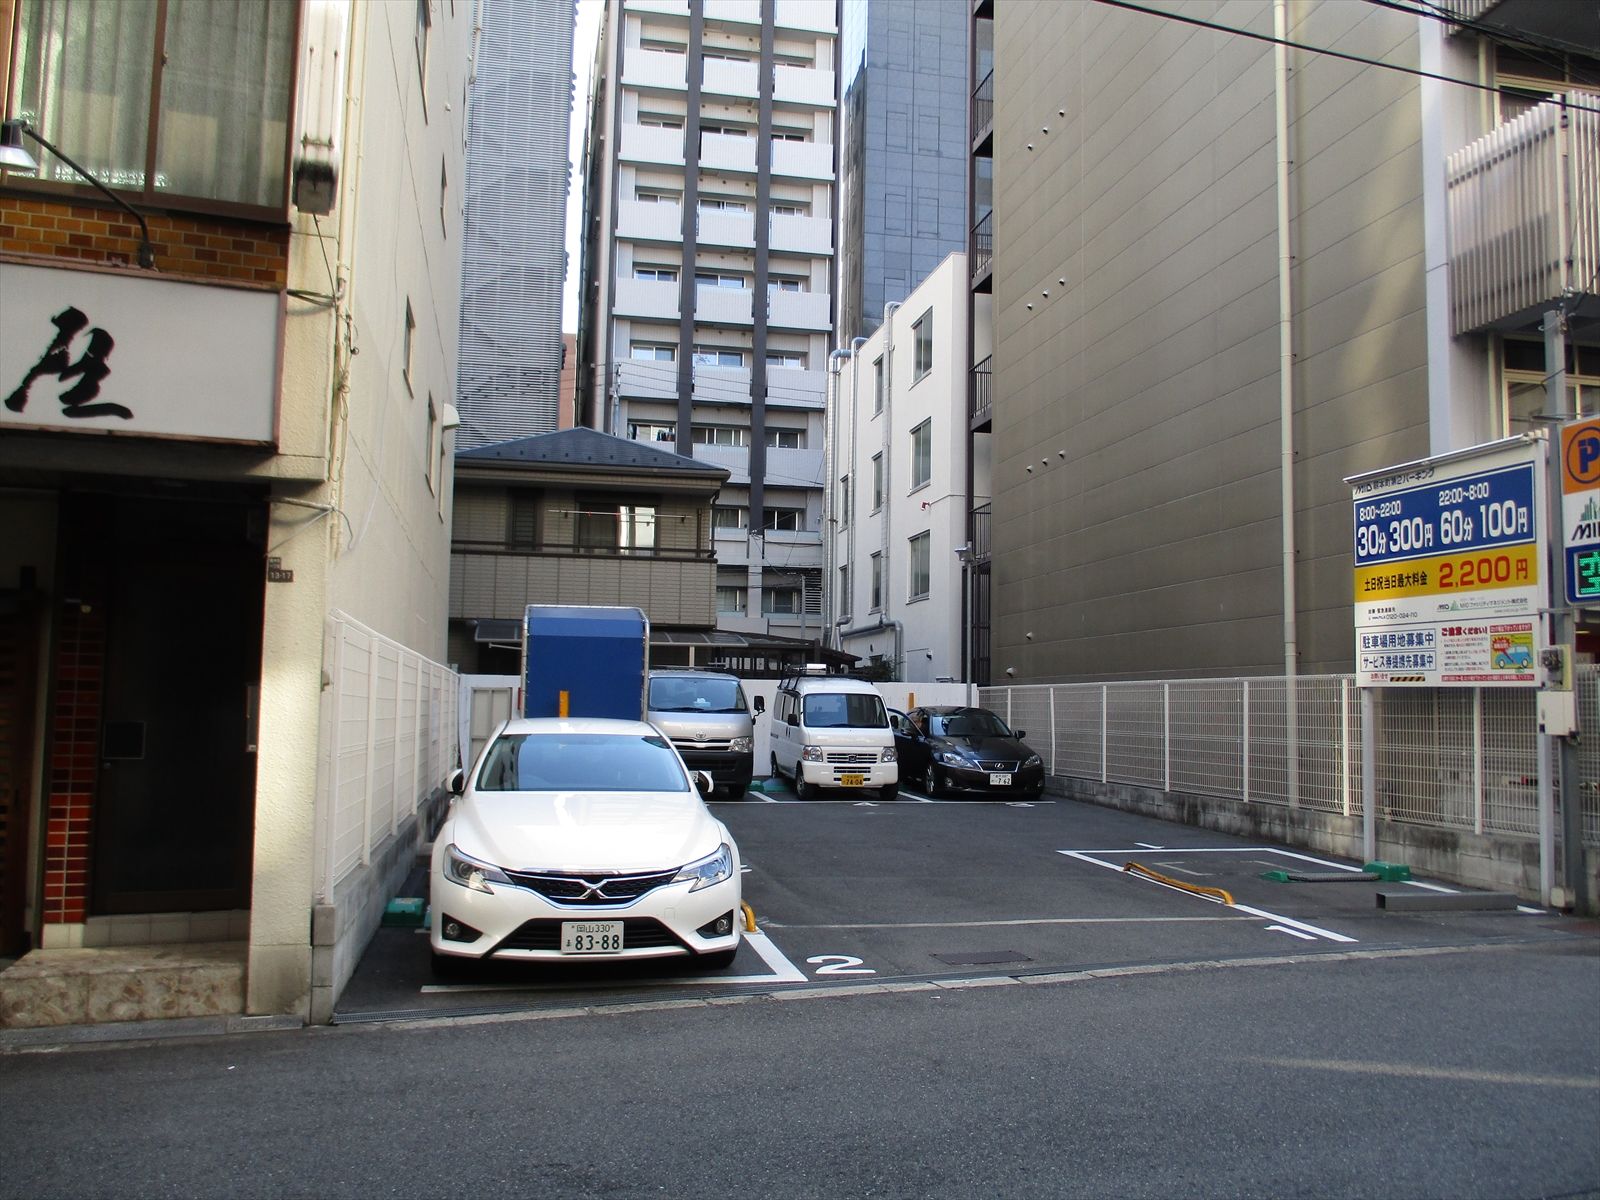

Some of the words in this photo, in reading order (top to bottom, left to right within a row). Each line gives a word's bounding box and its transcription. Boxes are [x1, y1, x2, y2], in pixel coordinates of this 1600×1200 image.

[1440, 510, 1473, 545] 60分
[1480, 500, 1528, 538] 100円
[1571, 520, 1600, 541] MI
[1358, 524, 1387, 557] 30分
[1389, 517, 1433, 553] 300円
[1364, 571, 1428, 592] 土日祝当日最大料金
[1362, 631, 1434, 649] 駐車場用地募集中
[575, 934, 620, 951] 83-88
[806, 955, 876, 975] 2
